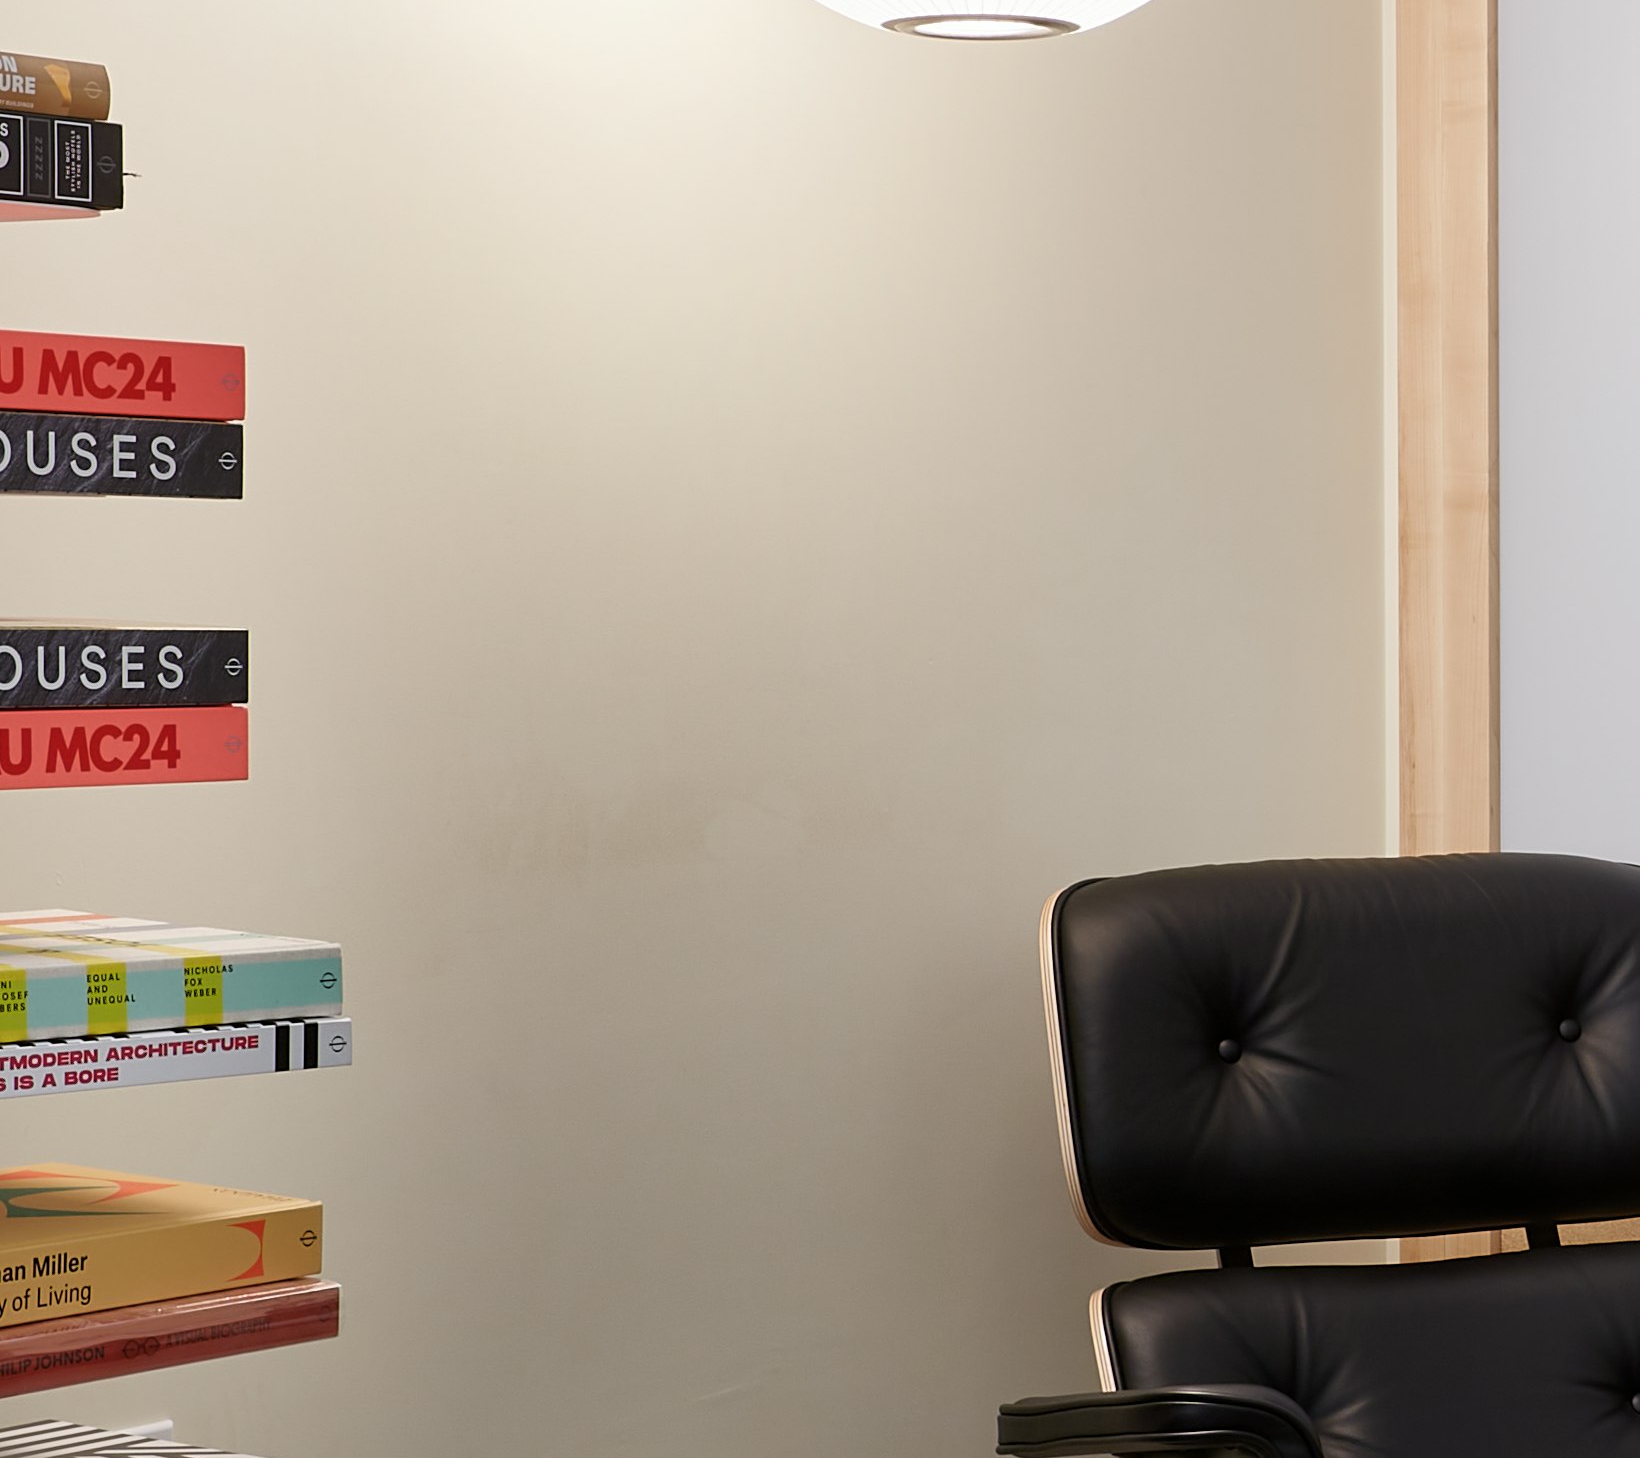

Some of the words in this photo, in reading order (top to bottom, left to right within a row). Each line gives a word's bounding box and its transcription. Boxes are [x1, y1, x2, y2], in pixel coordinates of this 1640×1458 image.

[0, 55, 18, 73] N
[37, 348, 177, 402] MC24
[0, 645, 185, 691] OUSES
[0, 728, 32, 776] U
[45, 723, 181, 773] MC24
[86, 972, 120, 983] EQUAL
[184, 964, 234, 976] NICHOLAS
[86, 984, 108, 995] AND
[184, 977, 203, 988] FOX
[184, 987, 217, 998] WEBER
[86, 994, 136, 1006] UNEQUAL
[0, 1049, 98, 1071] TMODERN
[105, 1035, 259, 1062] ARCHITECTURE
[14, 1075, 34, 1090] IS
[41, 1073, 57, 1088] A
[64, 1067, 119, 1086] BORE
[0, 1264, 26, 1283] an
[32, 1252, 88, 1279] Miller
[12, 1288, 31, 1311] of
[37, 1283, 91, 1306] Living
[210, 1317, 272, 1339] BIOGRAPHY
[33, 1346, 105, 1371] JOHNSON
